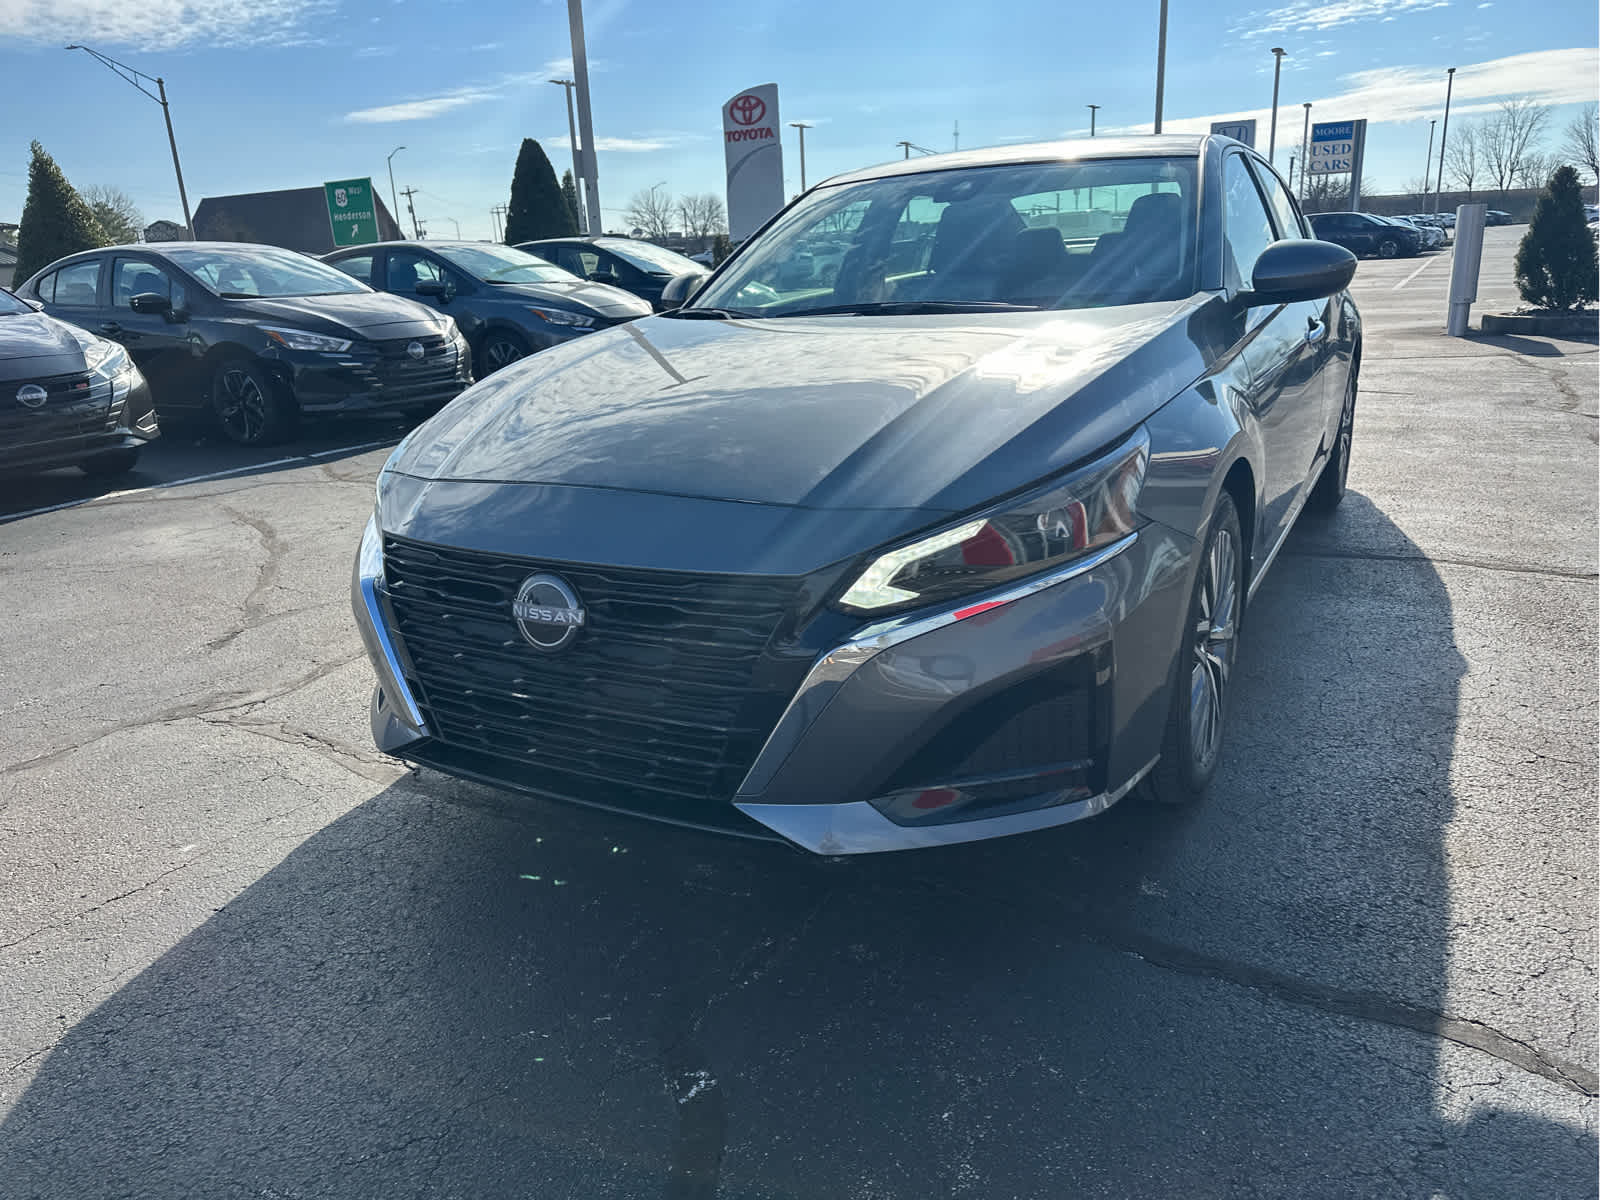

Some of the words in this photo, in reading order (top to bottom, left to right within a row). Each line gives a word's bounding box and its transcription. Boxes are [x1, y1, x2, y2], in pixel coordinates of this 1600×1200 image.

[725, 127, 774, 143] TOYOTA
[1315, 126, 1352, 137] MOORE
[1312, 143, 1352, 157] USED
[1311, 158, 1351, 172] CARS
[334, 211, 372, 222] Henderson
[512, 604, 584, 624] NISSAN
